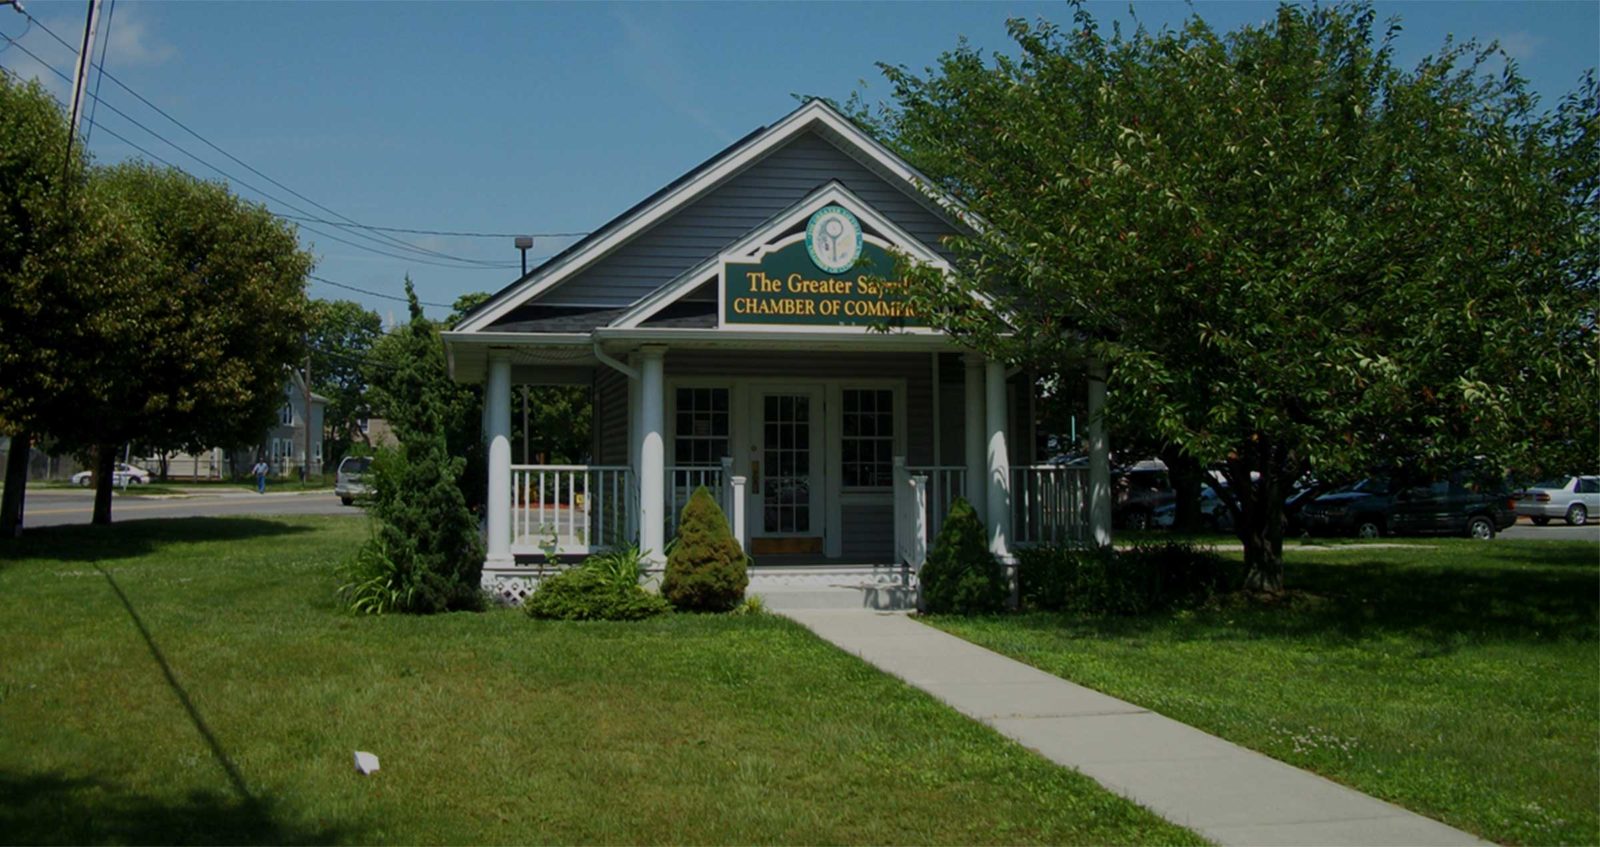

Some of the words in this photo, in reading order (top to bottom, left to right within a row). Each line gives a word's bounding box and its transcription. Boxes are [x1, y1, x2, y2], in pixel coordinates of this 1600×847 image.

[746, 272, 782, 292] The
[787, 273, 853, 294] Greater
[733, 297, 816, 315] CHAMBER
[819, 299, 842, 316] OF
